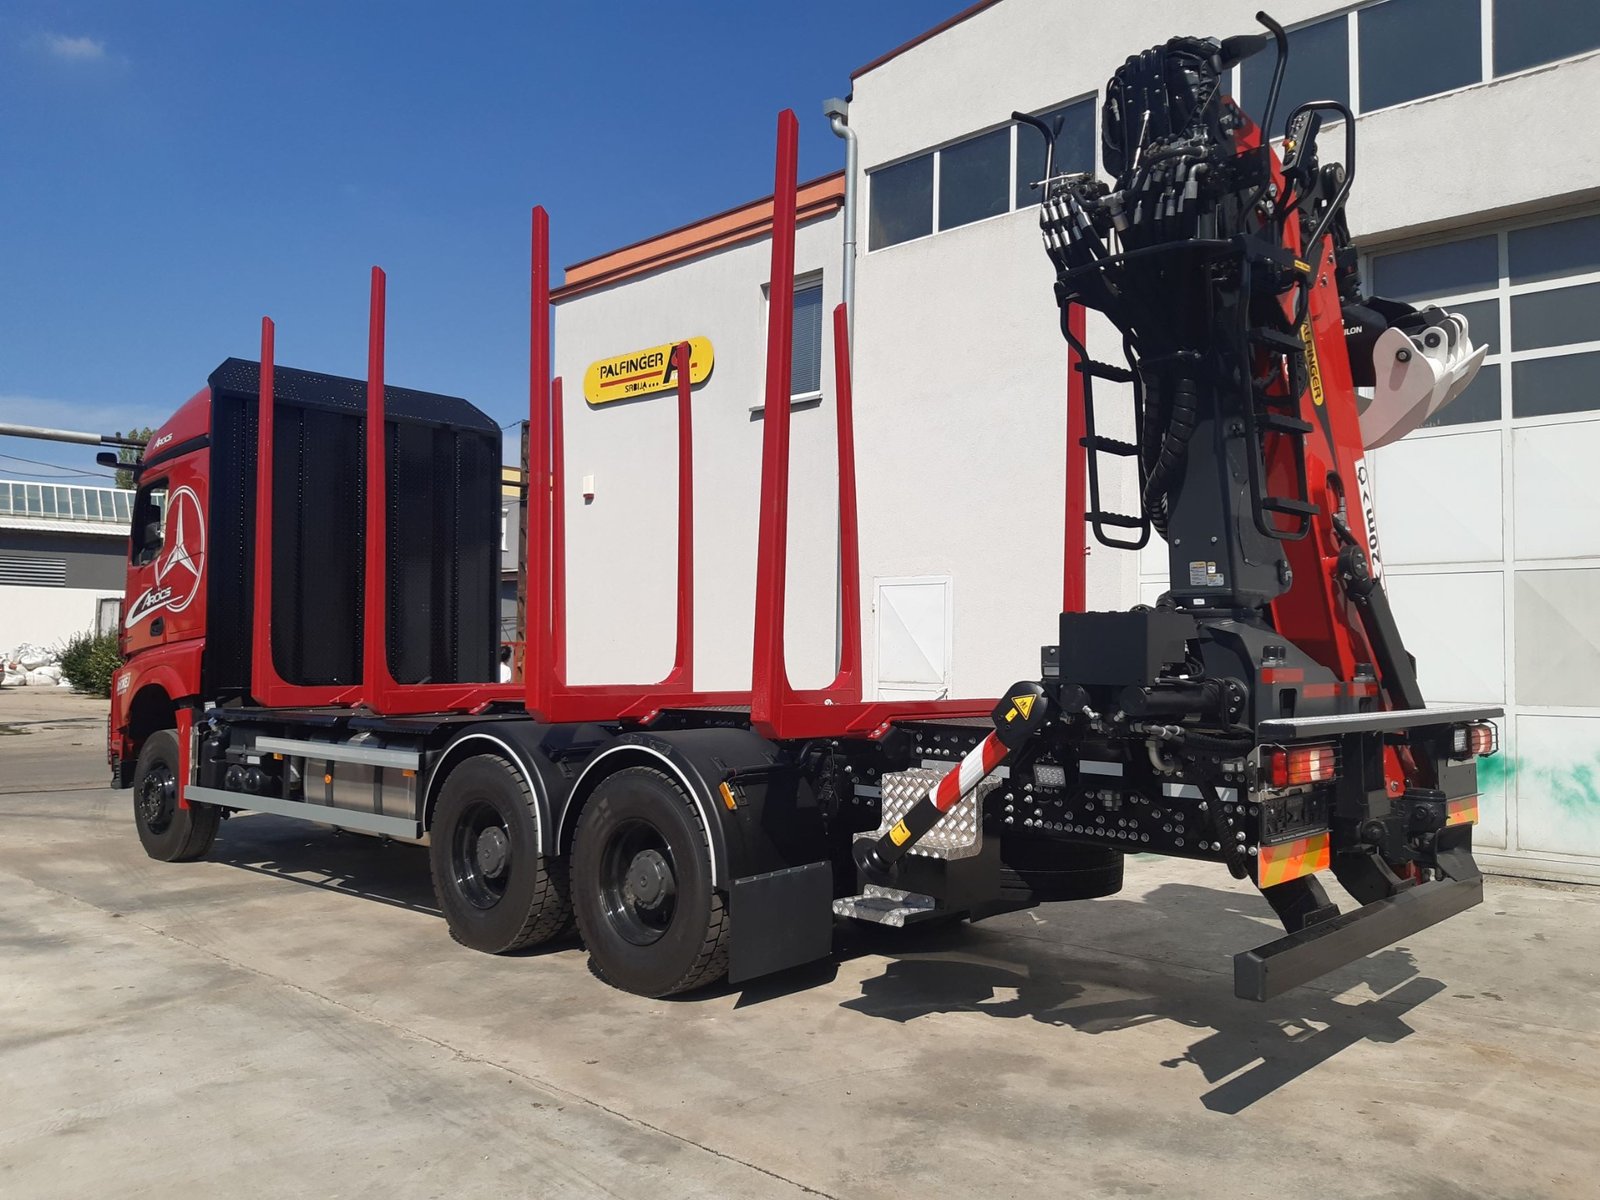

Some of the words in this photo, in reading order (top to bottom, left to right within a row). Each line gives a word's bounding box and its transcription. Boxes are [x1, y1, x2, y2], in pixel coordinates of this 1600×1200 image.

[600, 352, 664, 379] PALFINGER
[1301, 318, 1322, 400] ALFINGER
[1366, 508, 1382, 565] 20m
